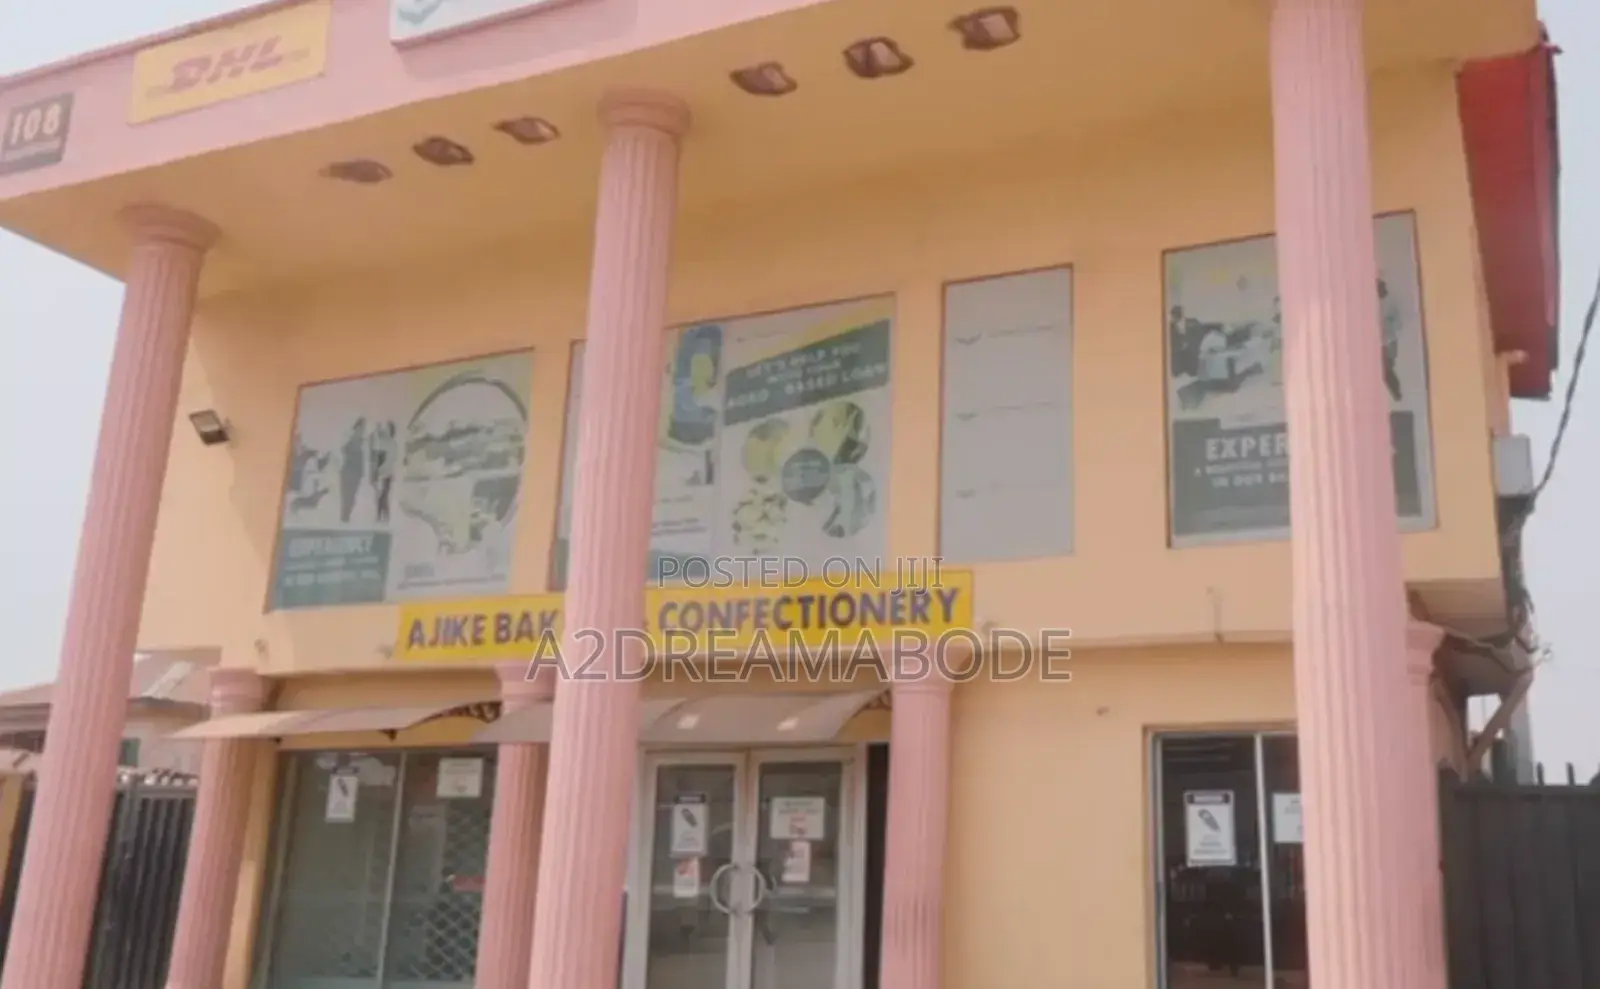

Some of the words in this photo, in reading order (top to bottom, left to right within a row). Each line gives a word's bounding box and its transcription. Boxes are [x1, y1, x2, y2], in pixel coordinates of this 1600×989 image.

[171, 35, 282, 91] DHL
[10, 103, 61, 146] 108
[407, 614, 488, 650] AJIKE
[657, 587, 961, 635] CONFECTIONERY
